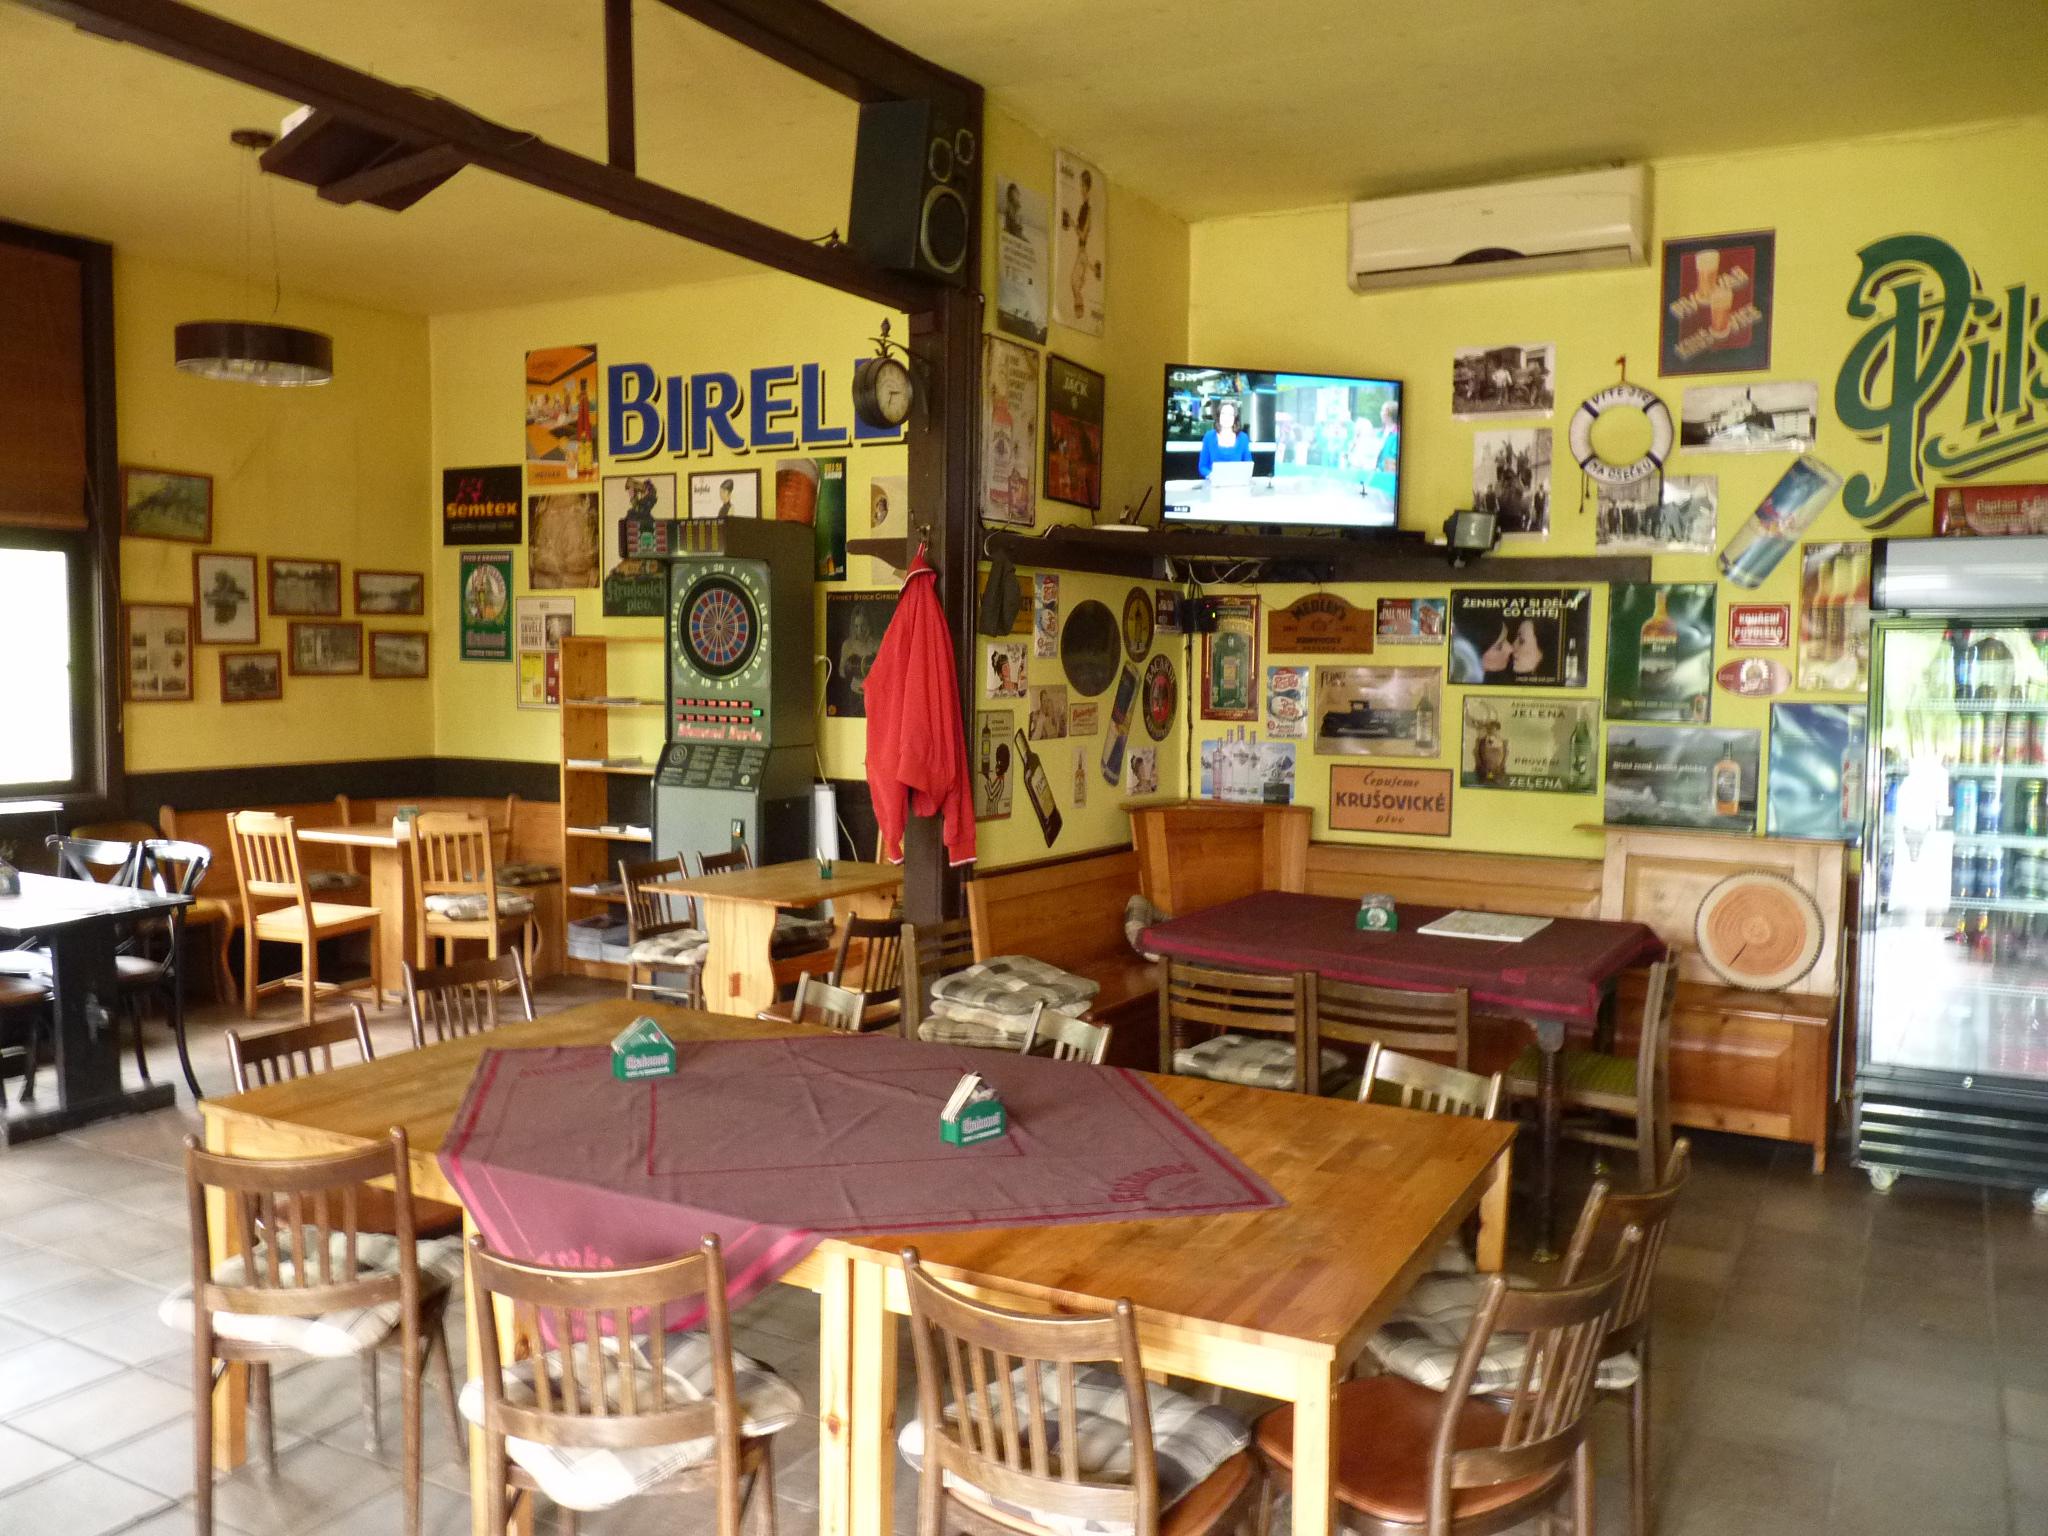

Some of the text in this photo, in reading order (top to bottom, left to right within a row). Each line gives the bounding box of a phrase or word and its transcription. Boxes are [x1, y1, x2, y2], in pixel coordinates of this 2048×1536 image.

[1503, 608, 1521, 617] CO
[1363, 770, 1420, 788] Čepujeme
[1336, 790, 1446, 813] KRUŠOVICKÉ
[1376, 814, 1405, 825] pivo
